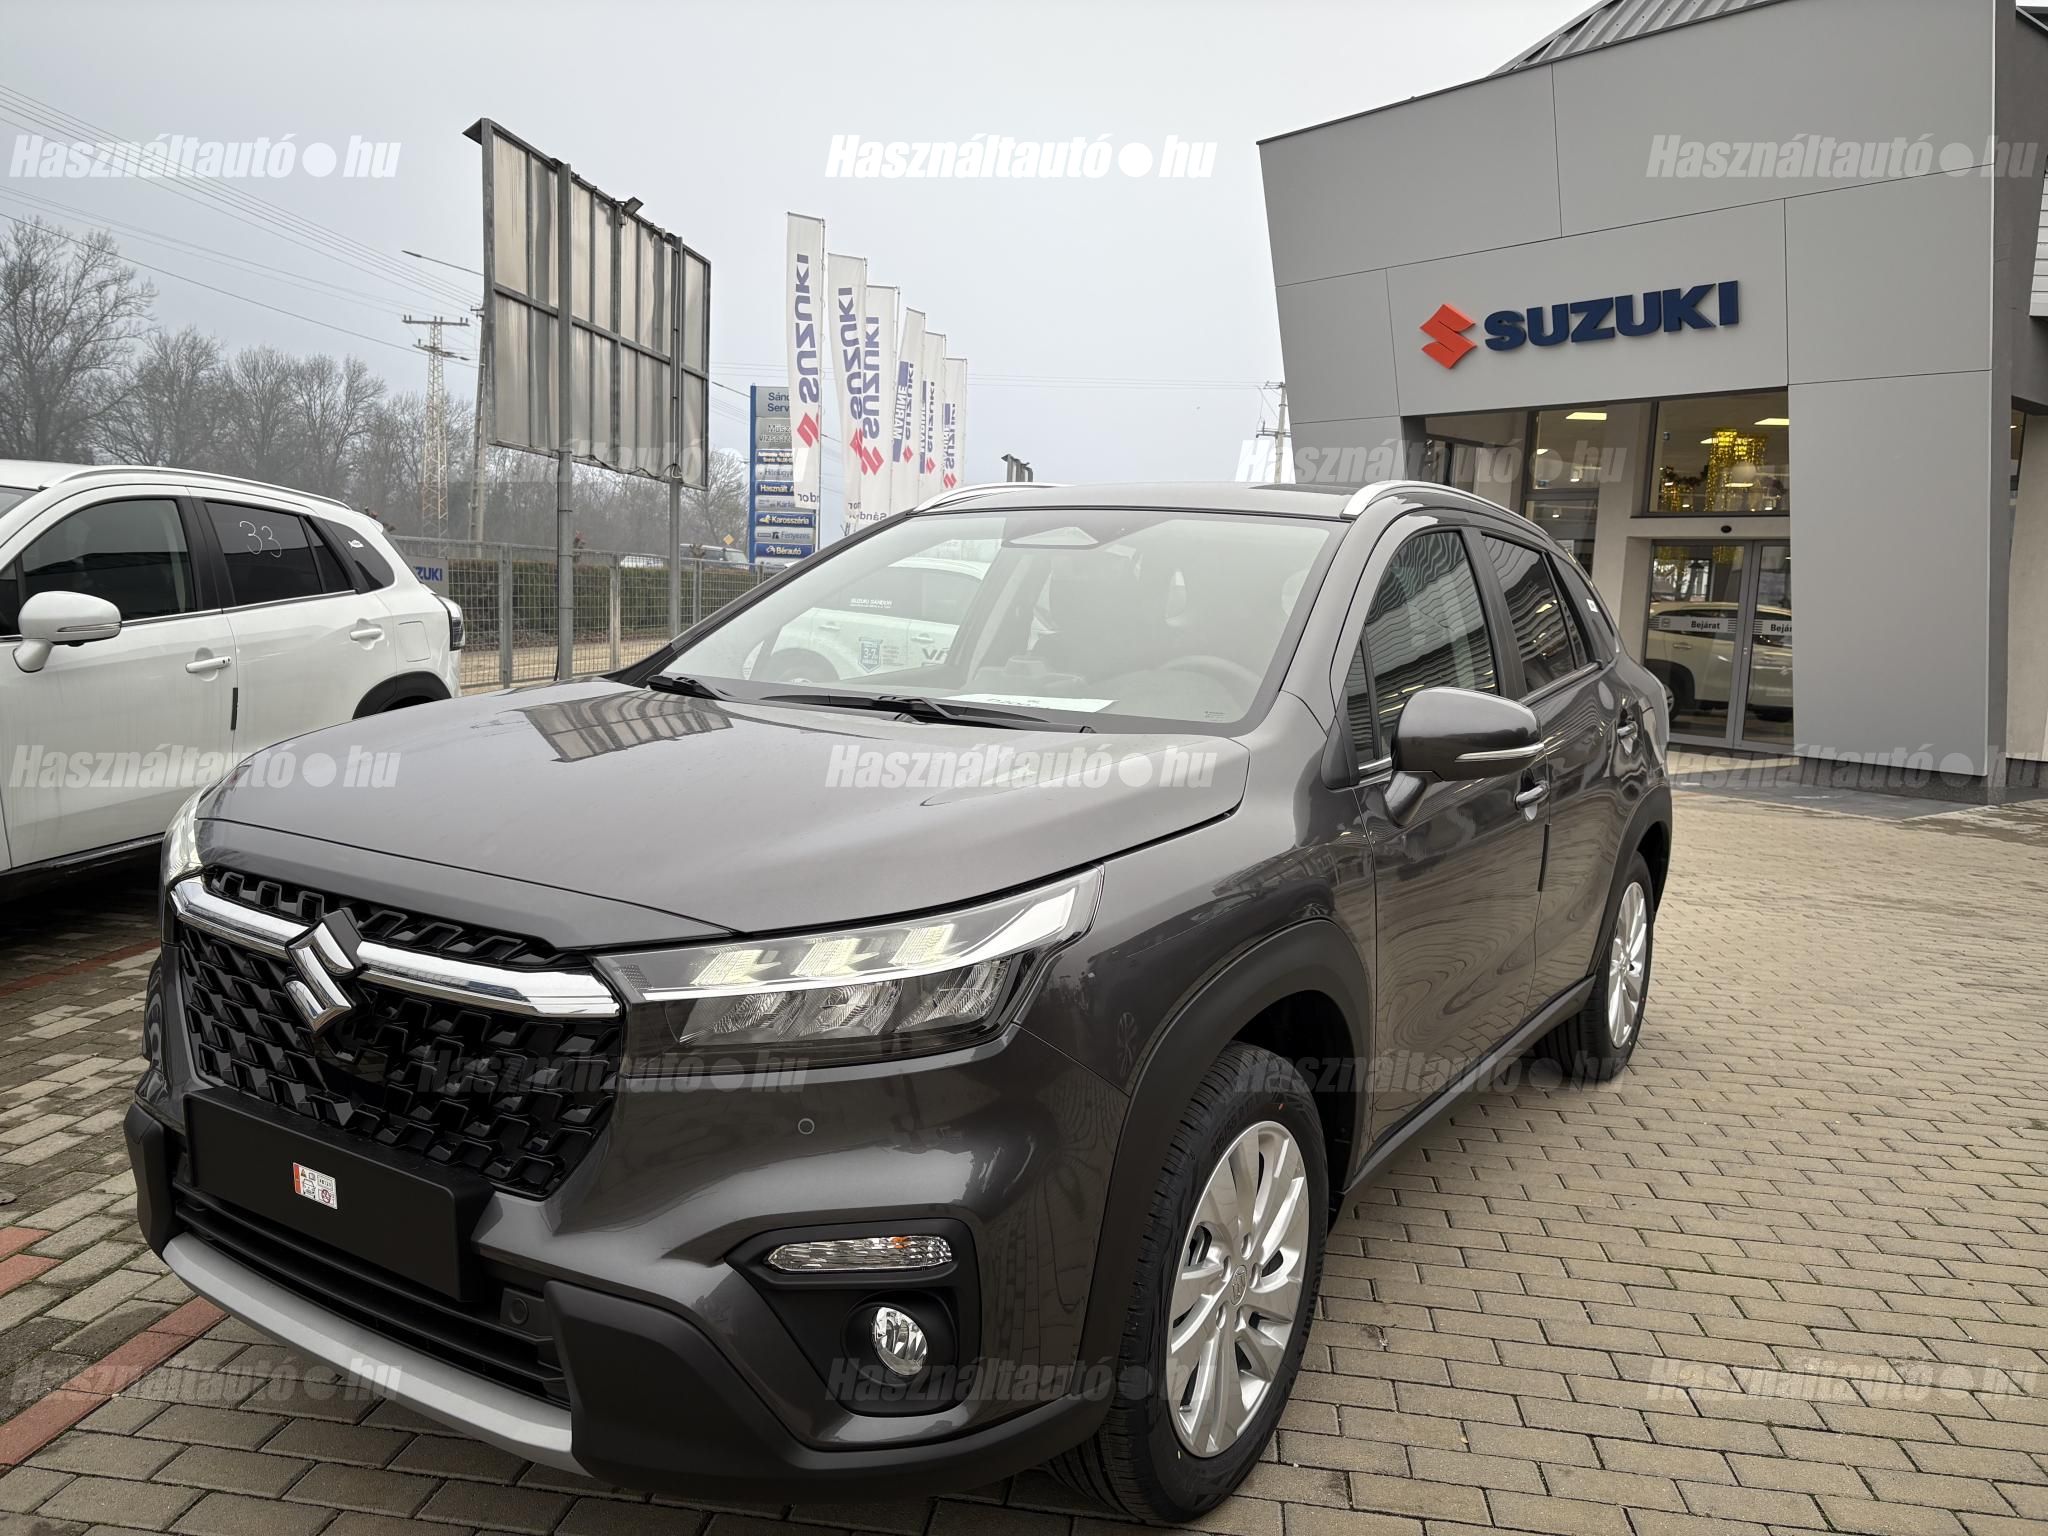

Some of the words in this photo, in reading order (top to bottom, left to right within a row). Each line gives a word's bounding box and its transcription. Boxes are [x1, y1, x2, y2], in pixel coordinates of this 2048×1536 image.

[1484, 280, 1739, 351] SUZUKI
[240, 520, 282, 558] 33
[415, 566, 443, 581] ZUKI
[1691, 621, 1720, 630] Bejárat
